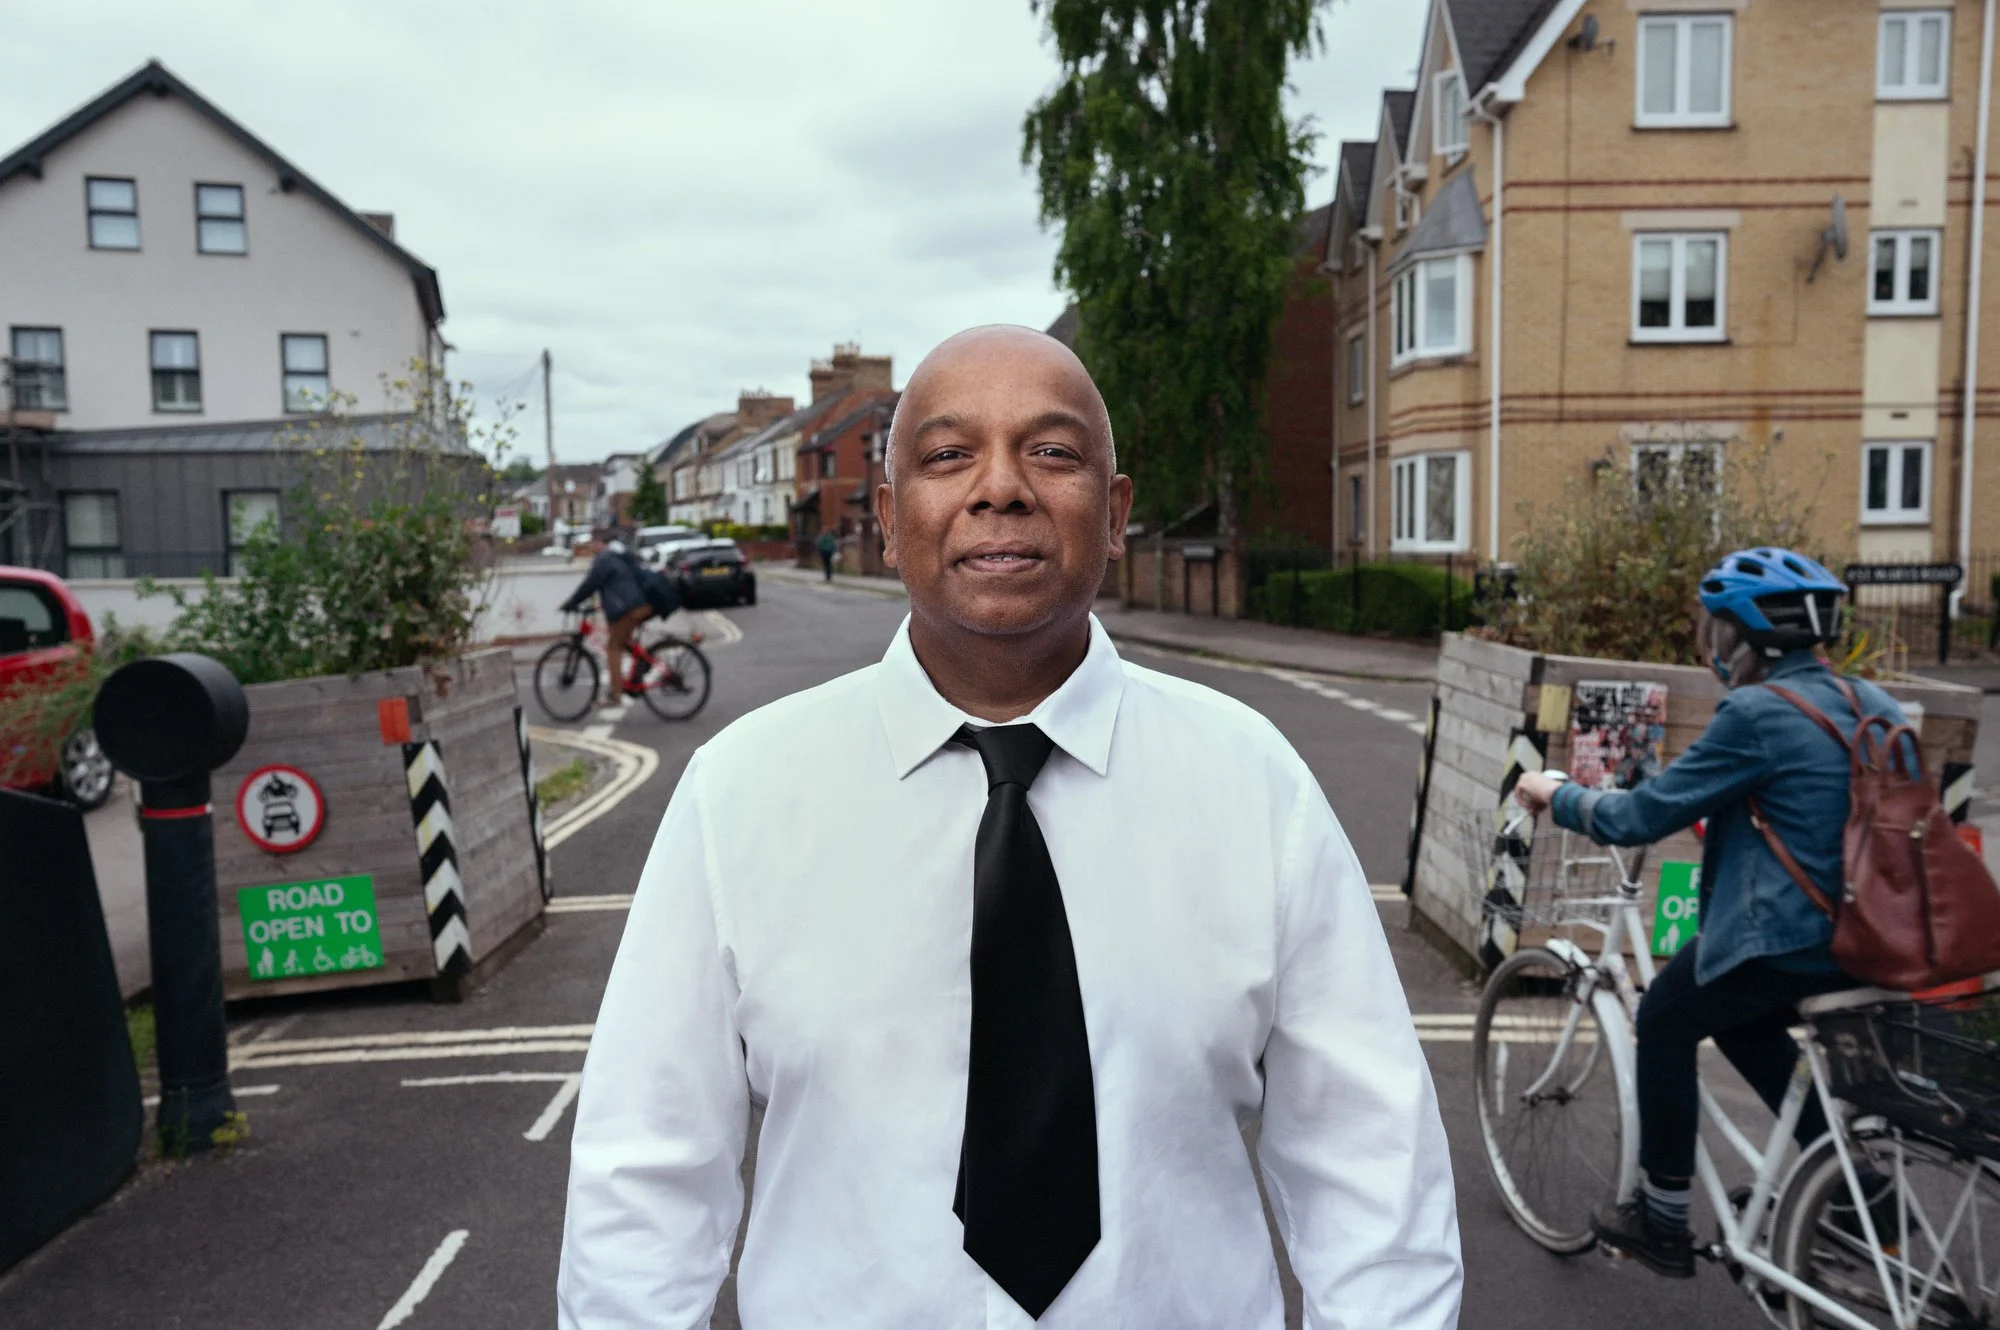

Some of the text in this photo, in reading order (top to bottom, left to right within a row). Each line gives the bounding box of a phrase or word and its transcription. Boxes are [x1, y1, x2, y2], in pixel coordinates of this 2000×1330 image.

[267, 884, 344, 912] ROAD
[1662, 895, 1699, 920] OP
[249, 910, 372, 943] OPEN TO
